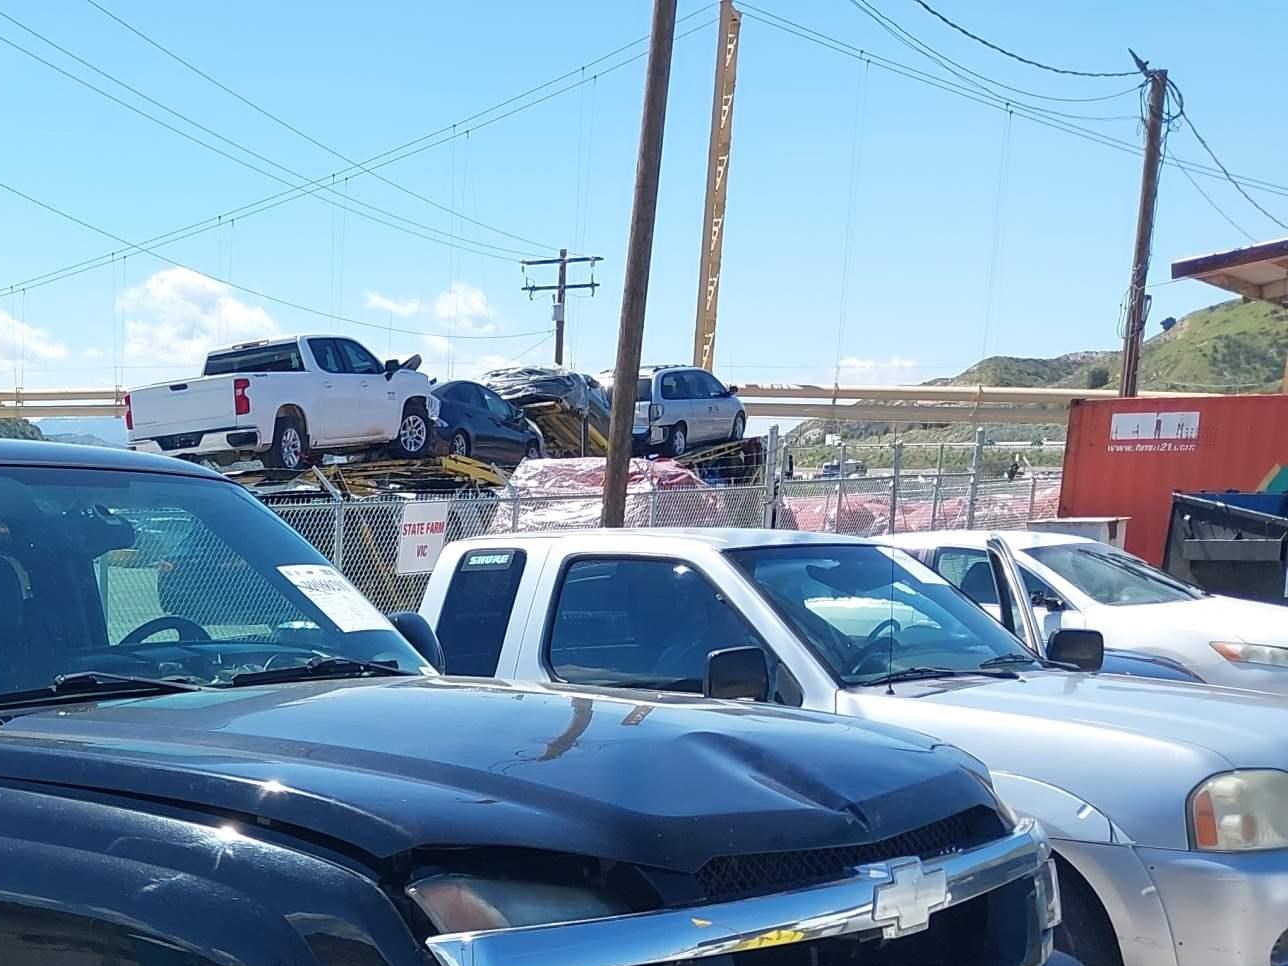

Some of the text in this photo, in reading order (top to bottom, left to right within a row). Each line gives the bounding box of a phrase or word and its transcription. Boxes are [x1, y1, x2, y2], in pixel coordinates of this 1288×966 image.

[403, 521, 445, 536] STATE FARM
[416, 545, 428, 557] VIC
[469, 554, 510, 565] SHURE
